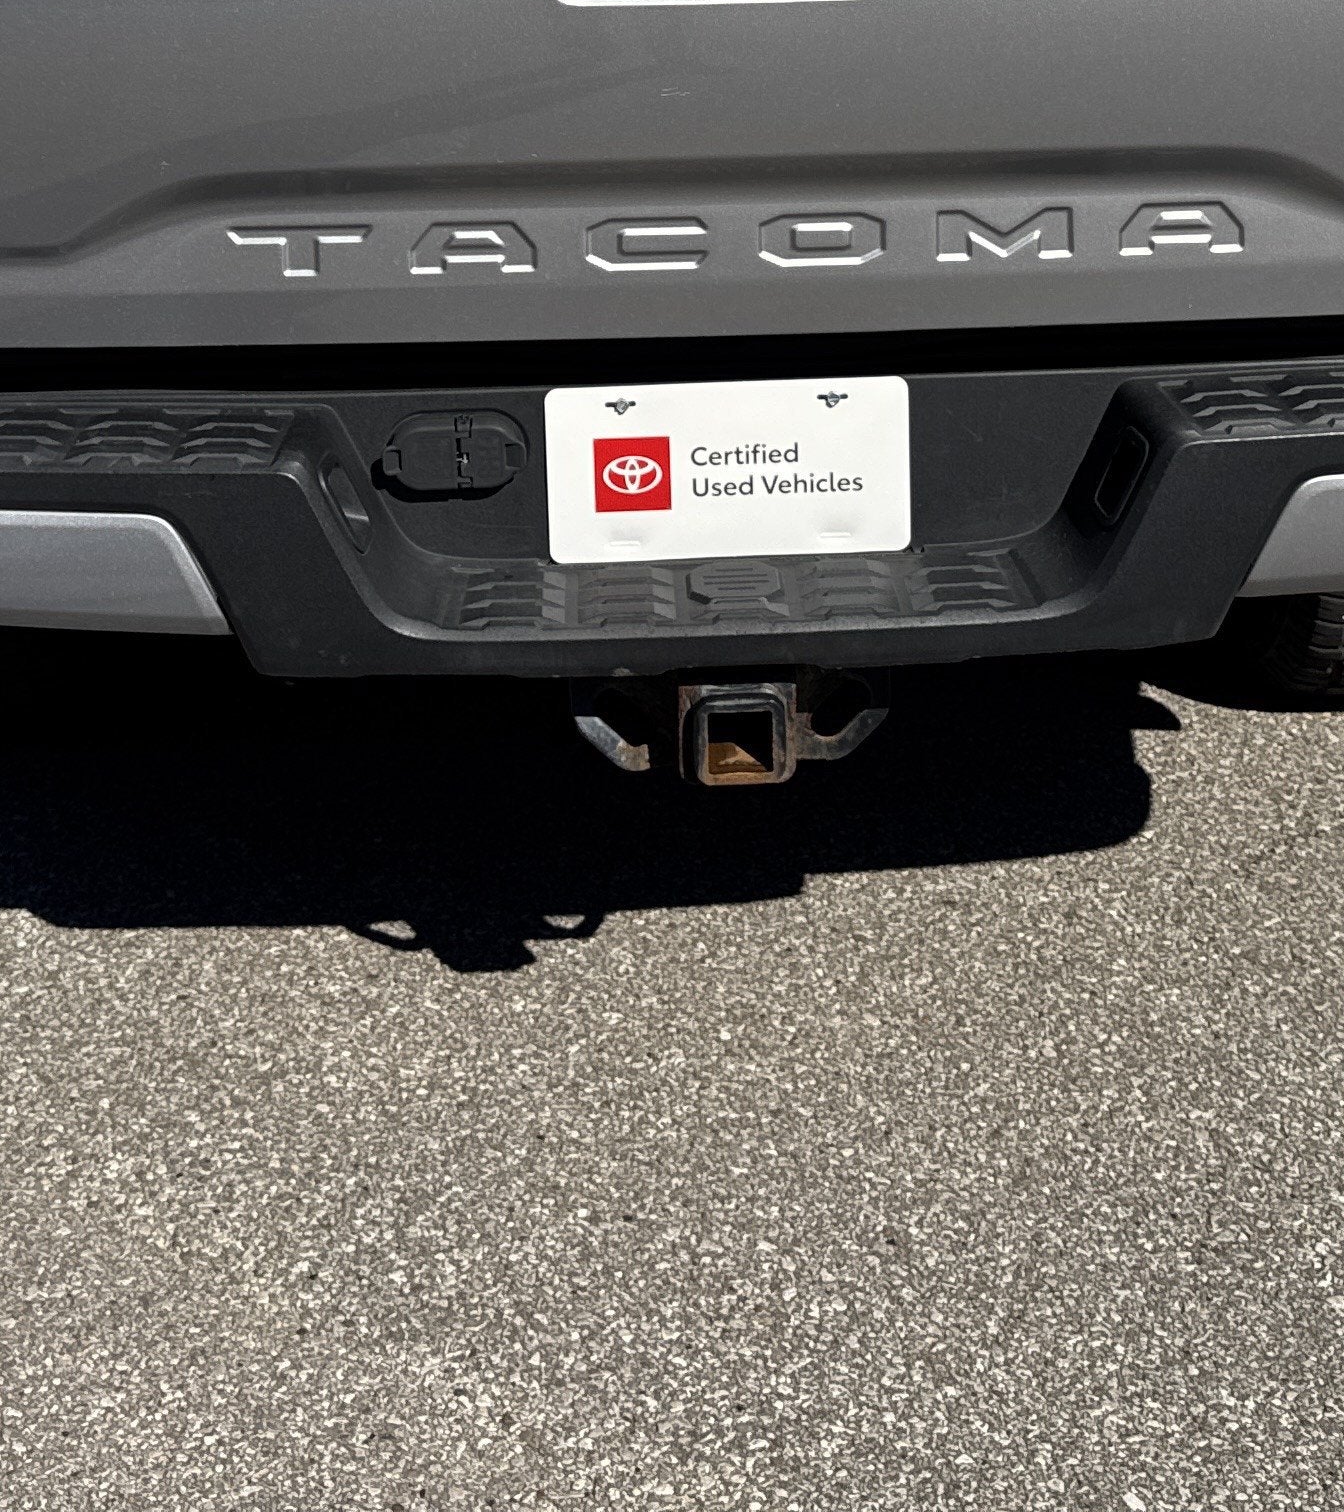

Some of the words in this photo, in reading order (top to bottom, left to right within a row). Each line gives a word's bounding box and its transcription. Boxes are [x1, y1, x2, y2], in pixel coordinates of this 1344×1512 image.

[226, 201, 1246, 278] TACOMA
[690, 441, 799, 467] Certified
[692, 474, 755, 498] Used
[760, 471, 864, 495] Vehicles
